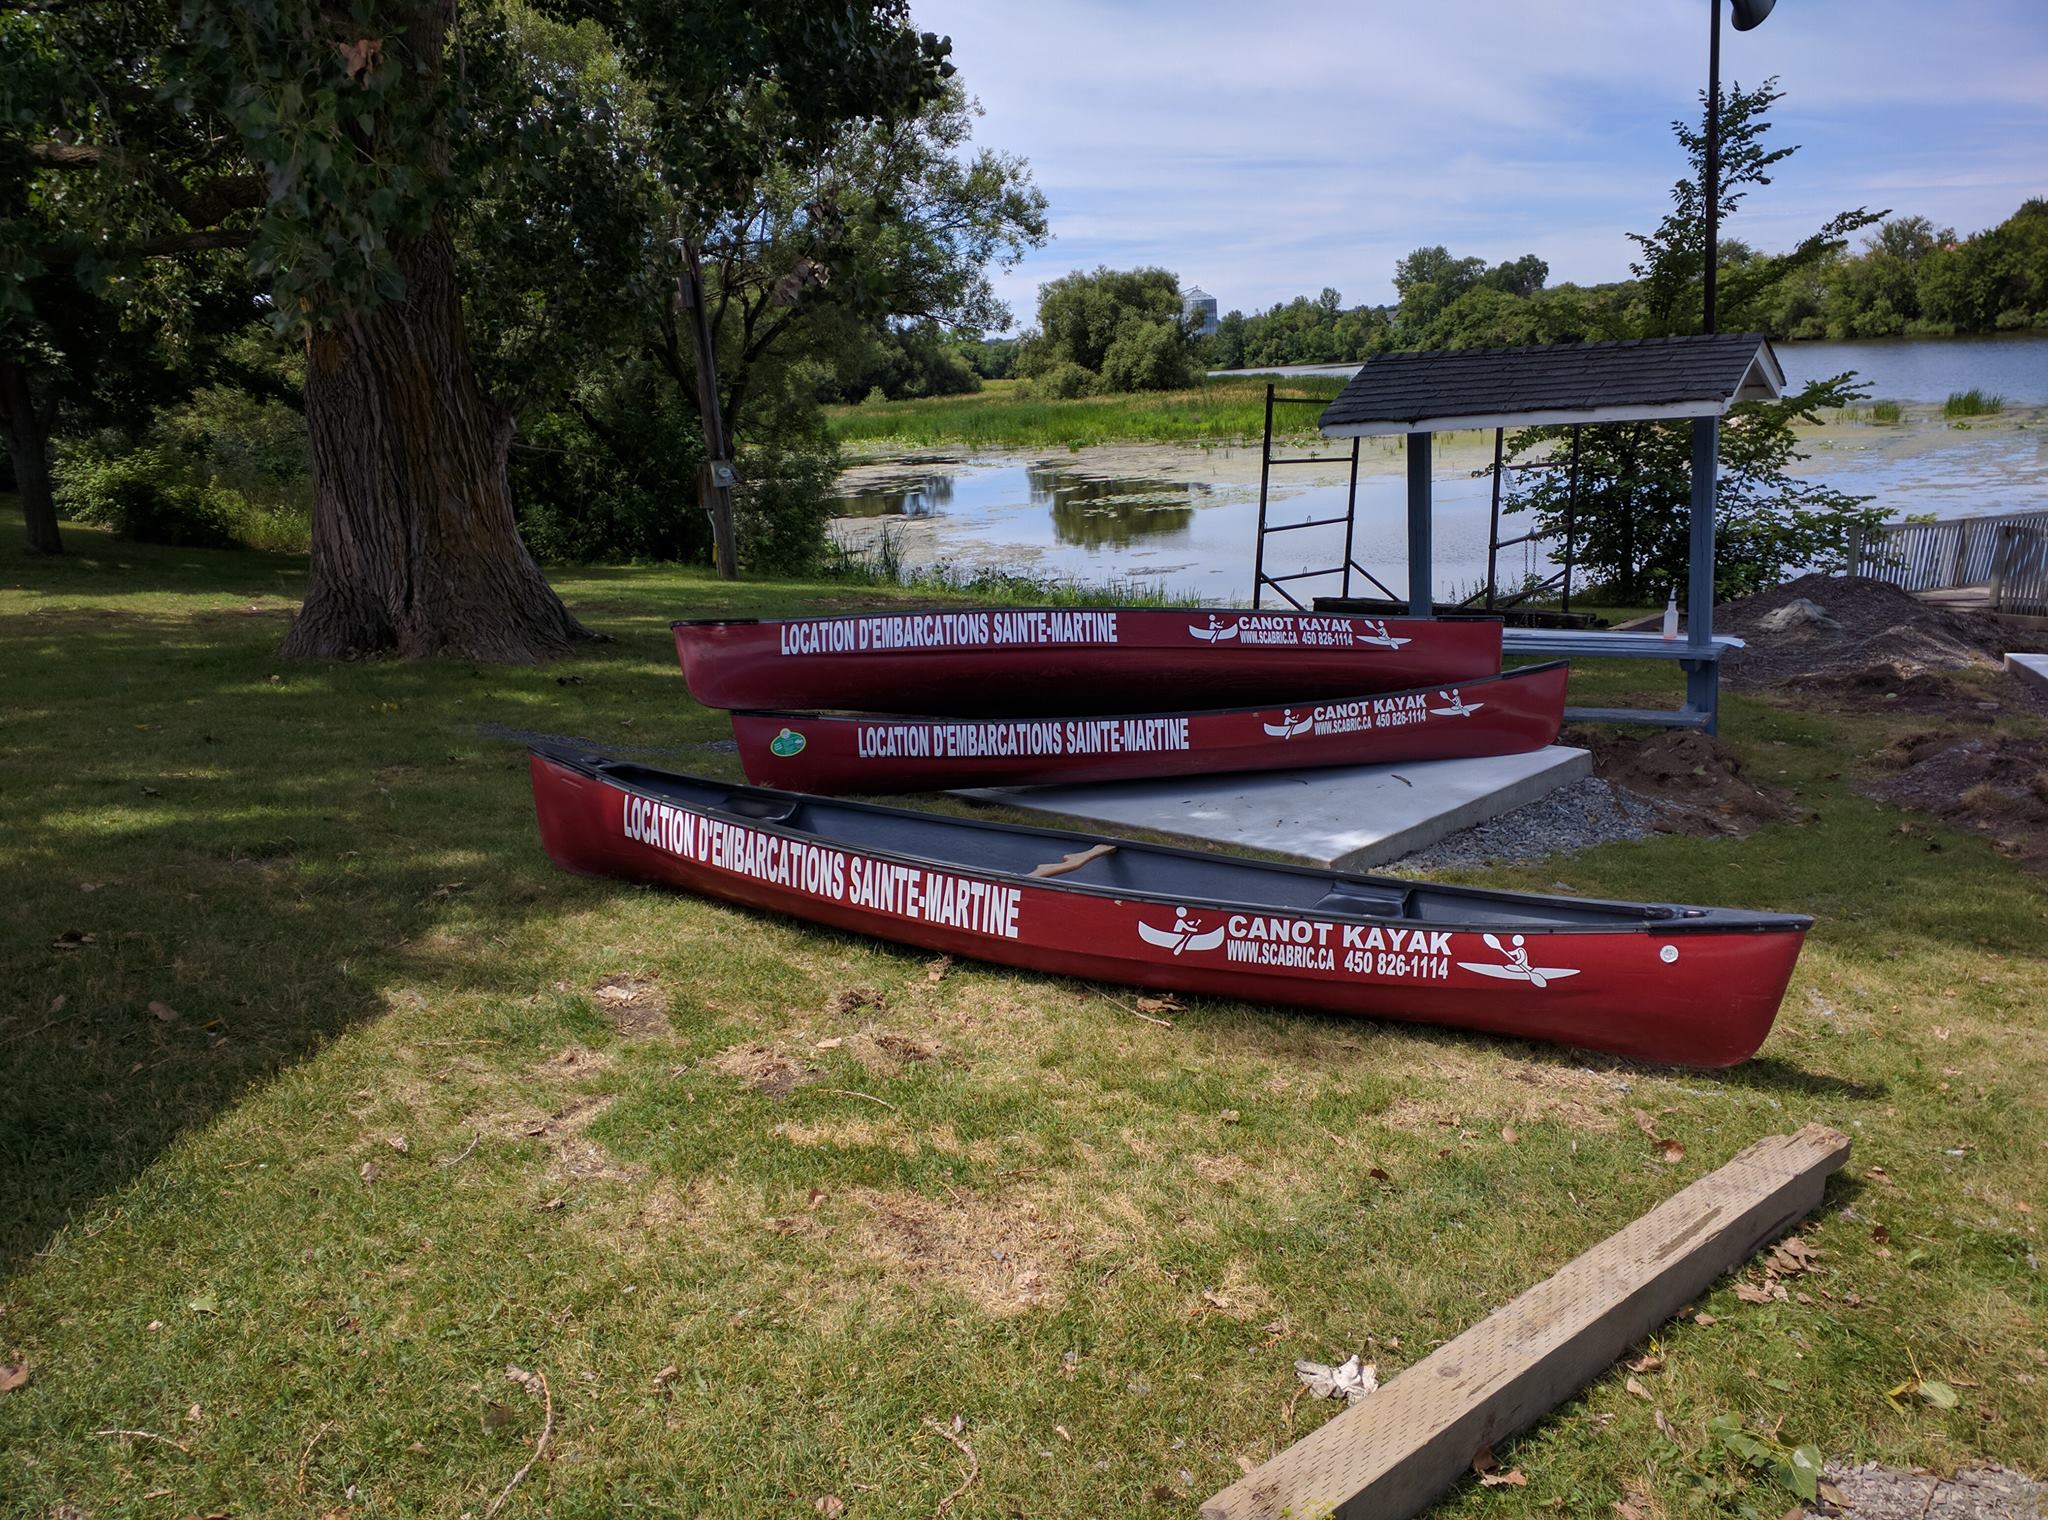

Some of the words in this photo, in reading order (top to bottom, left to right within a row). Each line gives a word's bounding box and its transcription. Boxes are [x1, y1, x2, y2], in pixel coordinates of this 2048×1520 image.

[781, 620, 855, 656] LOCATION
[859, 613, 989, 651] D'EMBARCATIONS
[993, 612, 1118, 644] SAINTE-MARTINE
[1238, 616, 1294, 631] CANOT
[1298, 618, 1353, 632] KAYAK
[1239, 630, 1299, 645] WWW.SCABRIC.CA
[1302, 631, 1317, 645] 450
[1318, 631, 1354, 646] 826-1114
[1313, 701, 1369, 721] CANOT
[1373, 694, 1427, 714] KAYAK
[1314, 715, 1372, 736] WWW.SCABRIC.CA
[1375, 713, 1391, 728] 450
[1392, 708, 1427, 726] 826-1114
[857, 726, 930, 759] LOCATION
[933, 722, 1063, 758] D'EMBARCATIONS
[1066, 717, 1190, 753] SAINTE-MARTINE
[623, 794, 695, 859] LOCATION
[698, 818, 845, 900] D'EMBARCATIONS
[849, 856, 1022, 939] SAINTE-MARTINE
[1228, 915, 1333, 945] CANOT
[1342, 924, 1453, 956] KAYAK
[1227, 939, 1335, 971] WWW.SCABRIC.CA
[1343, 950, 1373, 974] 450
[1377, 952, 1449, 980] 826-1114
